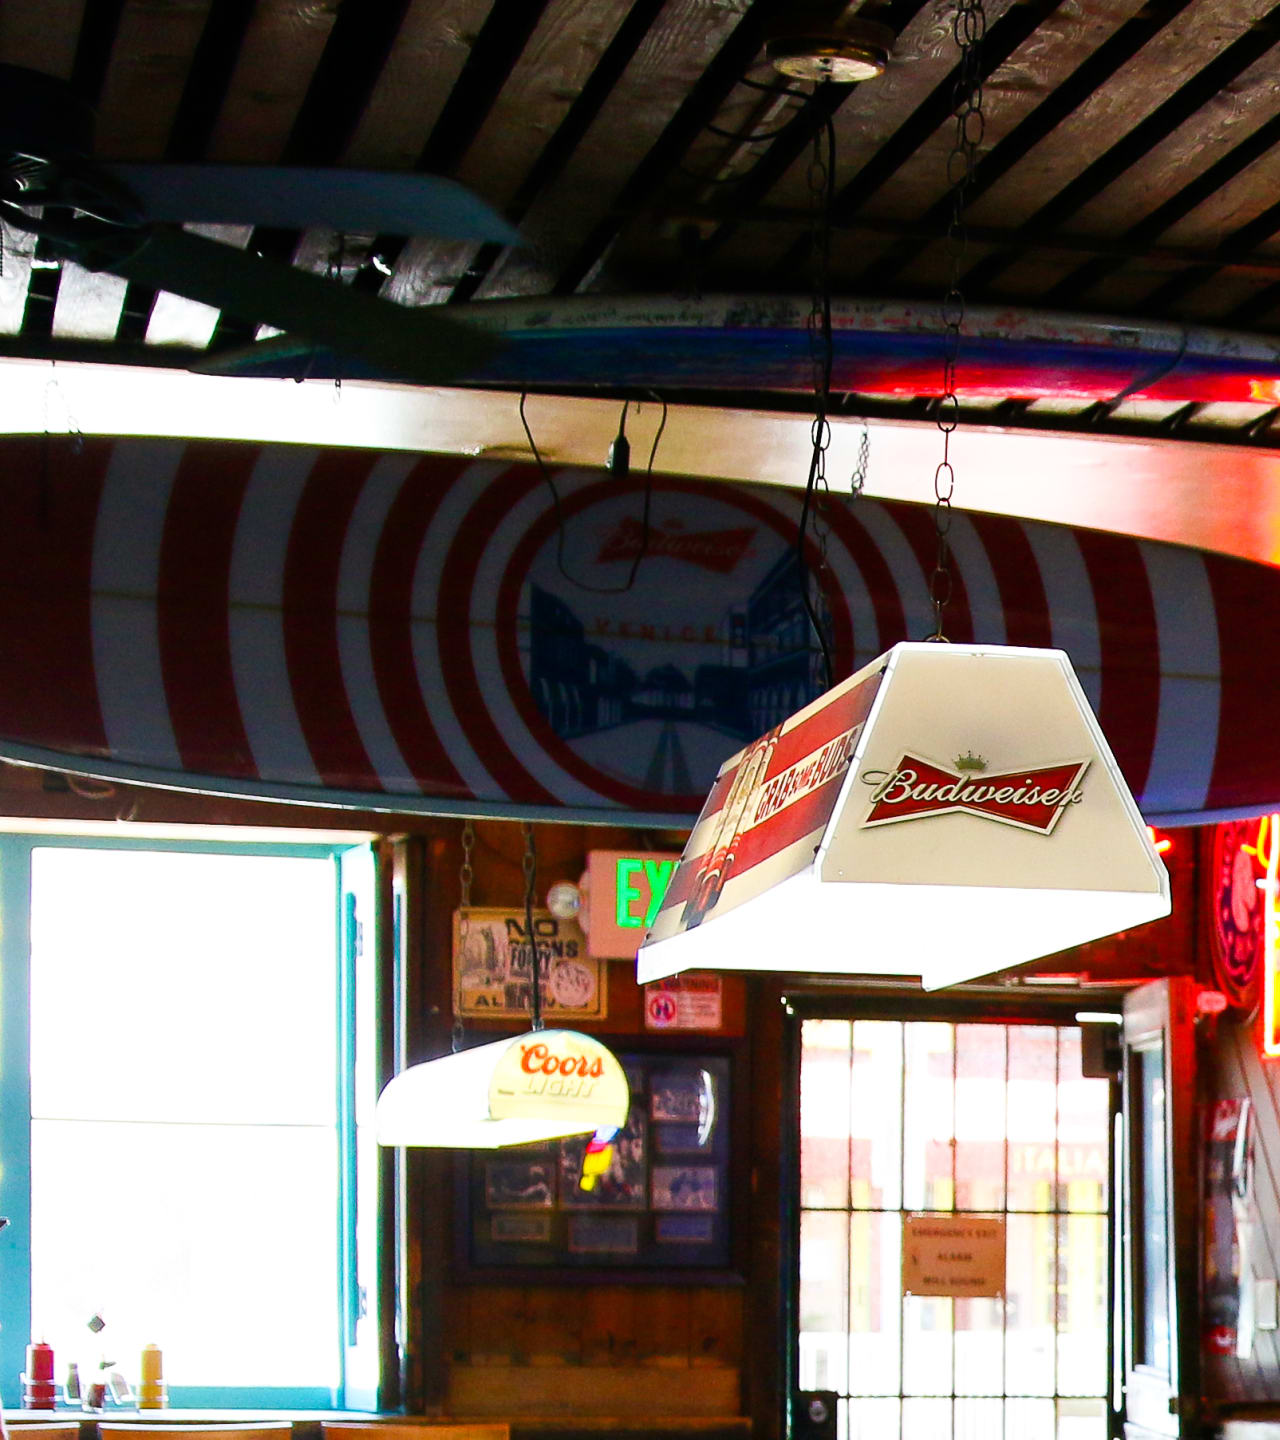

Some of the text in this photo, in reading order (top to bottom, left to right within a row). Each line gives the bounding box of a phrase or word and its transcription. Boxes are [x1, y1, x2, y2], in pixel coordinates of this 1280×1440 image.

[597, 522, 758, 560] Budweiser
[594, 615, 719, 643] VENICE
[753, 767, 797, 824] GRAB
[808, 727, 859, 789] BUDS
[860, 767, 1083, 810] Budweiser
[520, 1043, 605, 1079] Coors
